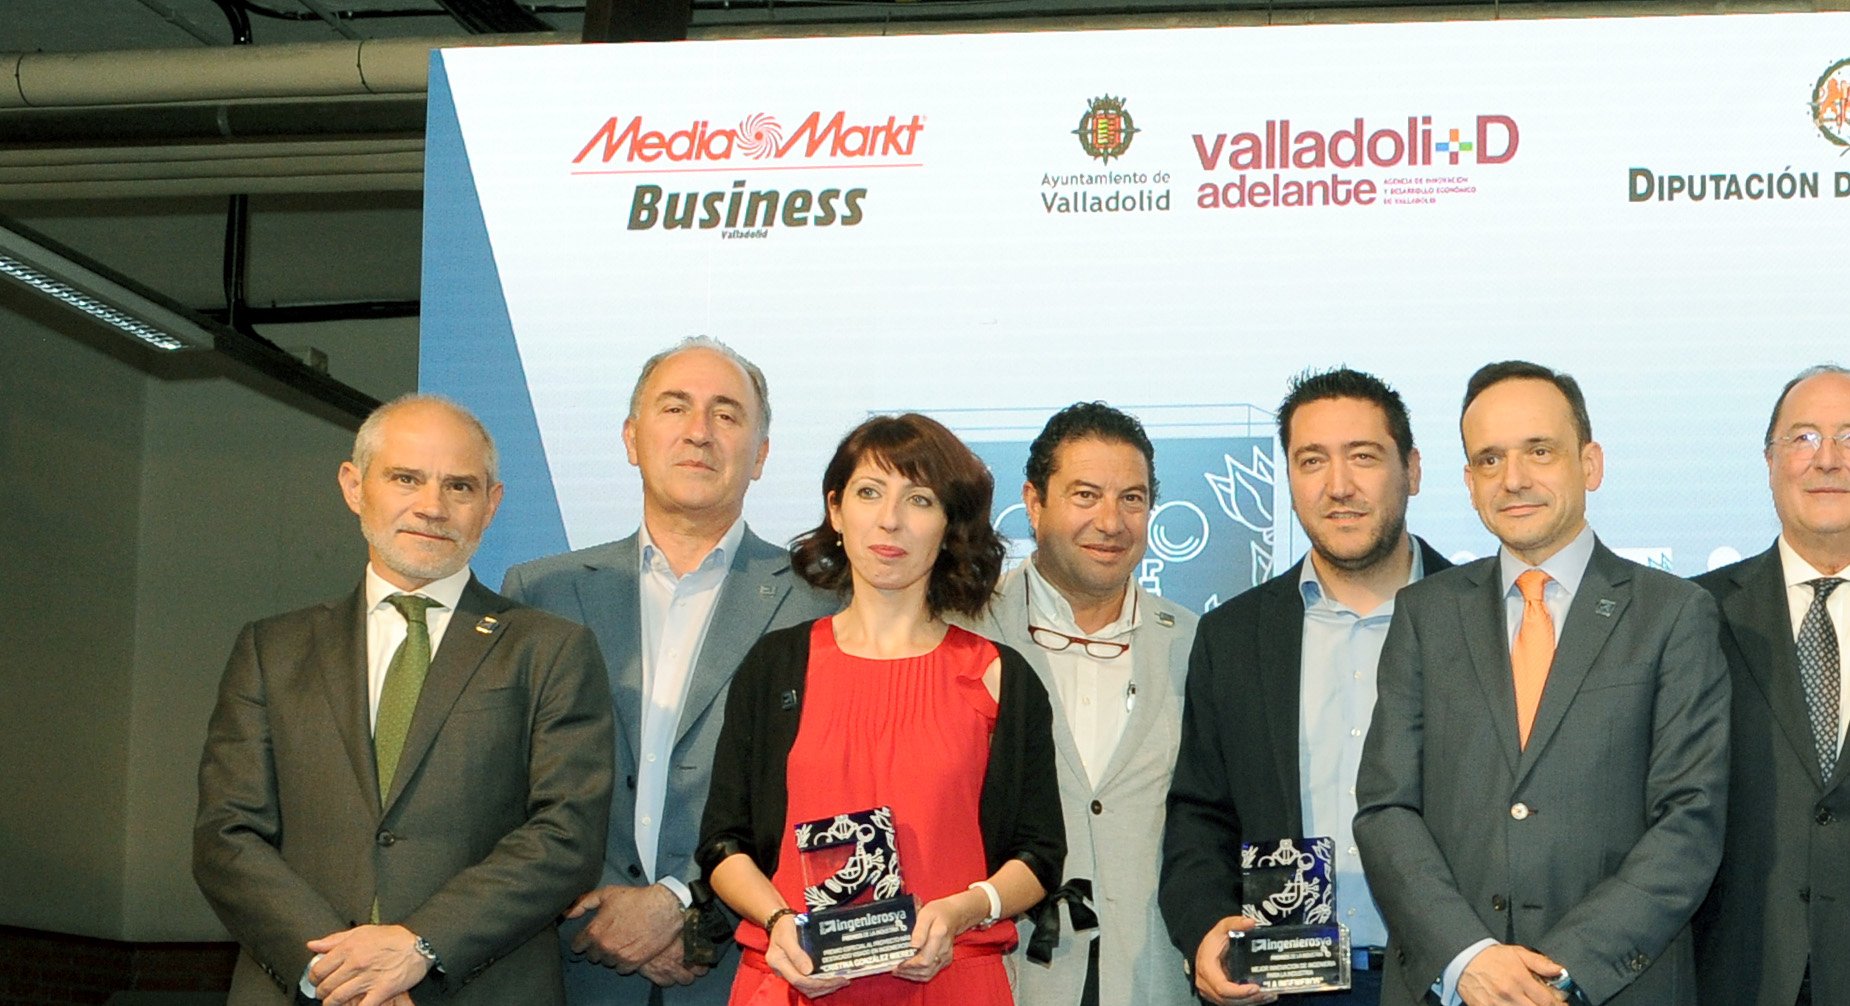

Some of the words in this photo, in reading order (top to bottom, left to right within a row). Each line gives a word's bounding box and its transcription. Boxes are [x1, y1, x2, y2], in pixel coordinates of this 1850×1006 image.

[571, 116, 737, 163] Media
[774, 110, 925, 159] Markt
[1041, 171, 1148, 189] Ayuntamiento
[1152, 170, 1171, 184] de
[1197, 173, 1377, 208] adelante
[1628, 166, 1819, 202] DIPUTACIÓN
[627, 180, 867, 231] Business
[1041, 189, 1170, 213] Valladolid
[721, 229, 768, 240] Valladolid
